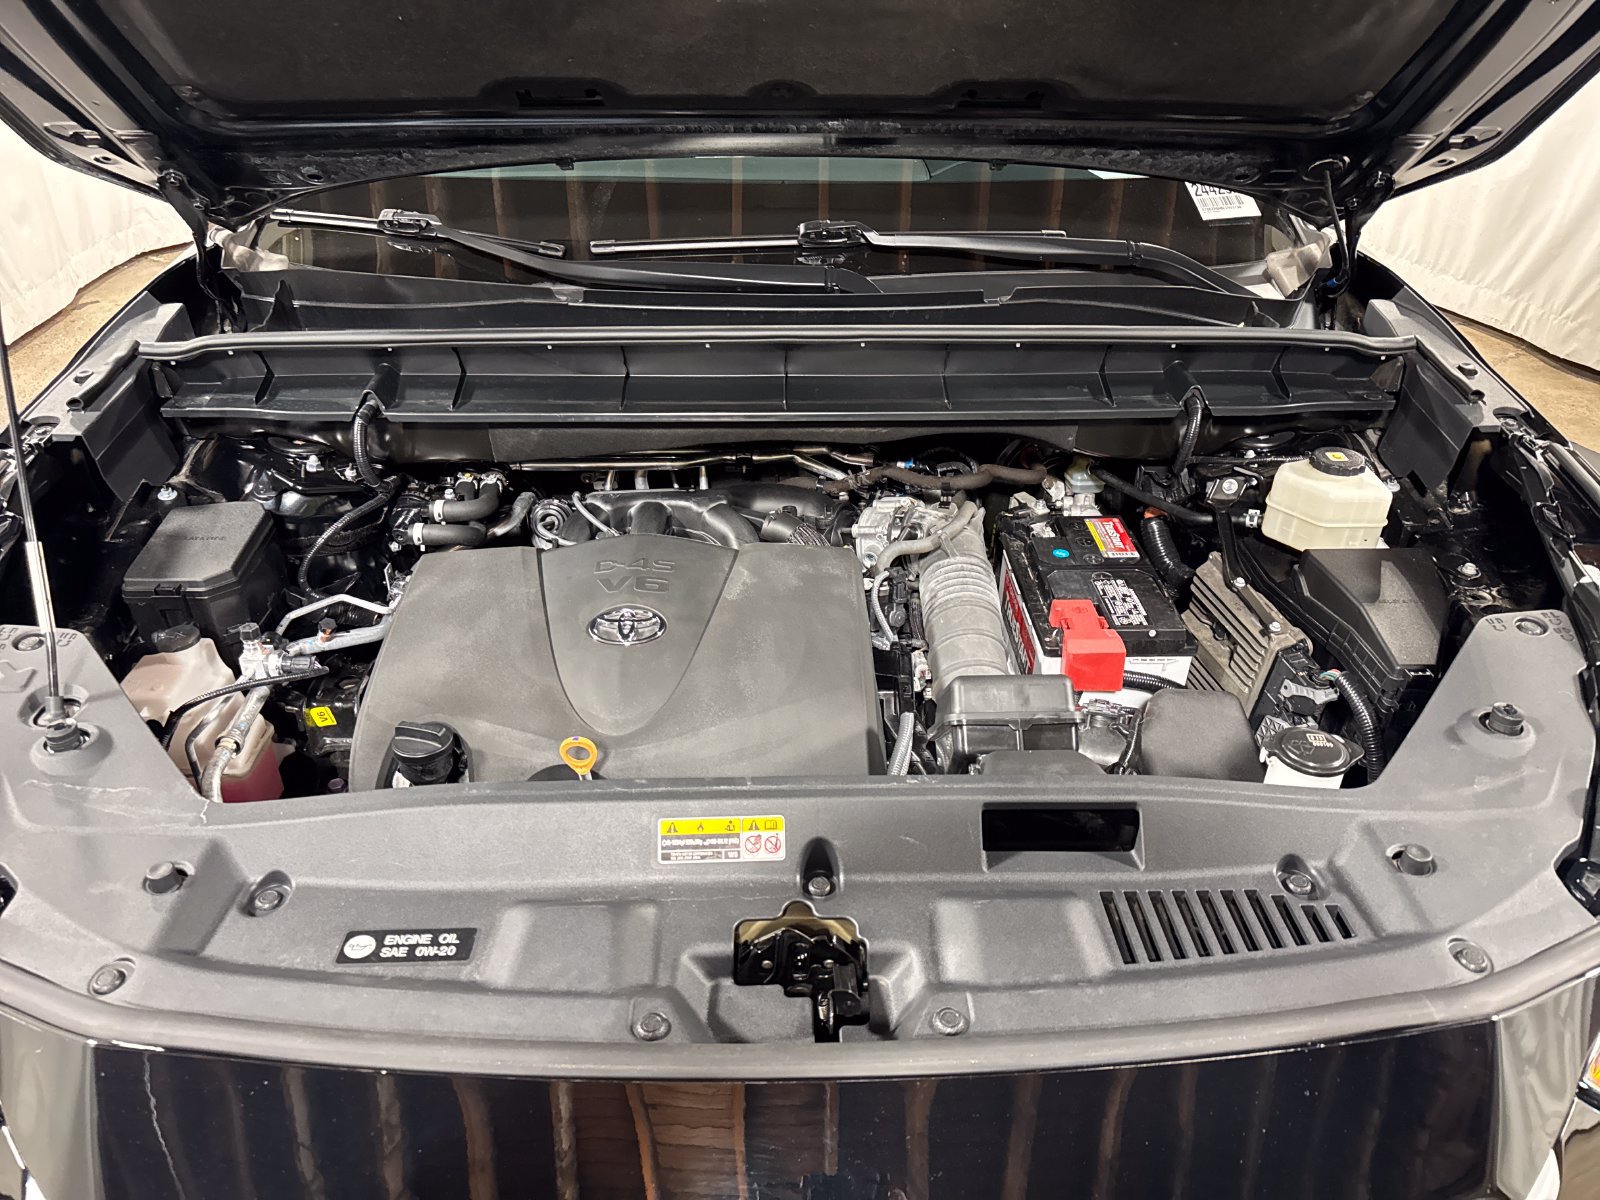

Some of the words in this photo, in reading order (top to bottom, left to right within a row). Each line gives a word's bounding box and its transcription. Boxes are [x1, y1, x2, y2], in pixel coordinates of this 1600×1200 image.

[597, 576, 669, 593] V6
[383, 934, 432, 945] ENGINE
[438, 933, 459, 944] OIL
[380, 947, 407, 957] SAE
